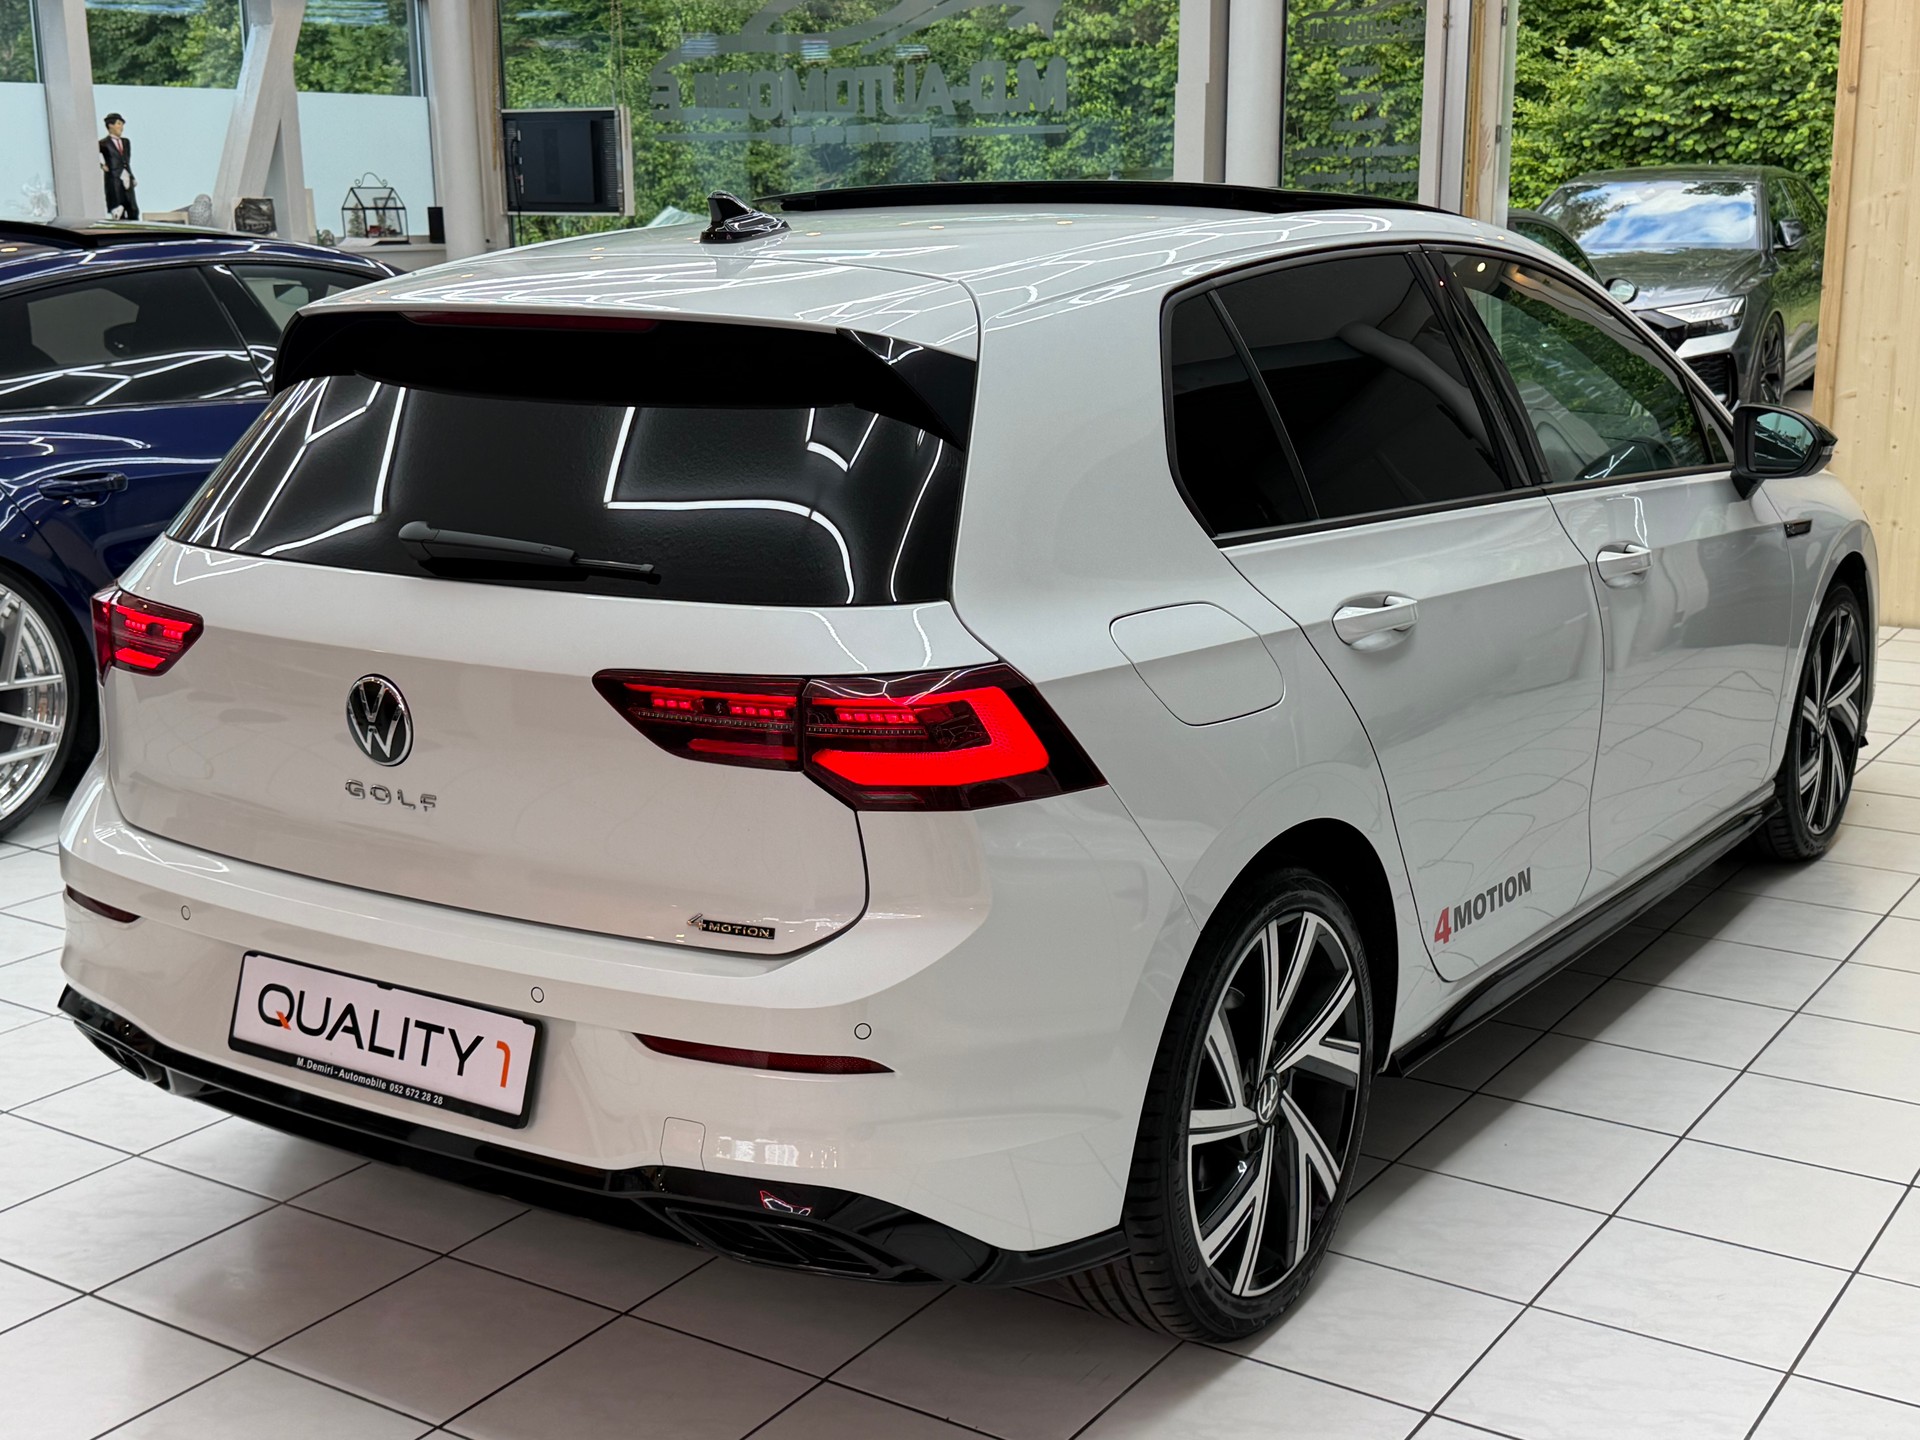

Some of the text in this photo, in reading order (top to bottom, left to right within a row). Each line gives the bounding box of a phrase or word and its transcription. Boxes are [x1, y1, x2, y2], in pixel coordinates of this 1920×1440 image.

[345, 779, 437, 812] GOLF
[1434, 867, 1531, 944] 4MOTION
[258, 983, 485, 1077] QUALITY
[338, 1069, 386, 1090] Automobile
[389, 1083, 404, 1094] 052
[405, 1087, 420, 1098] 672
[421, 1091, 431, 1102] 28
[433, 1094, 443, 1105] 28
